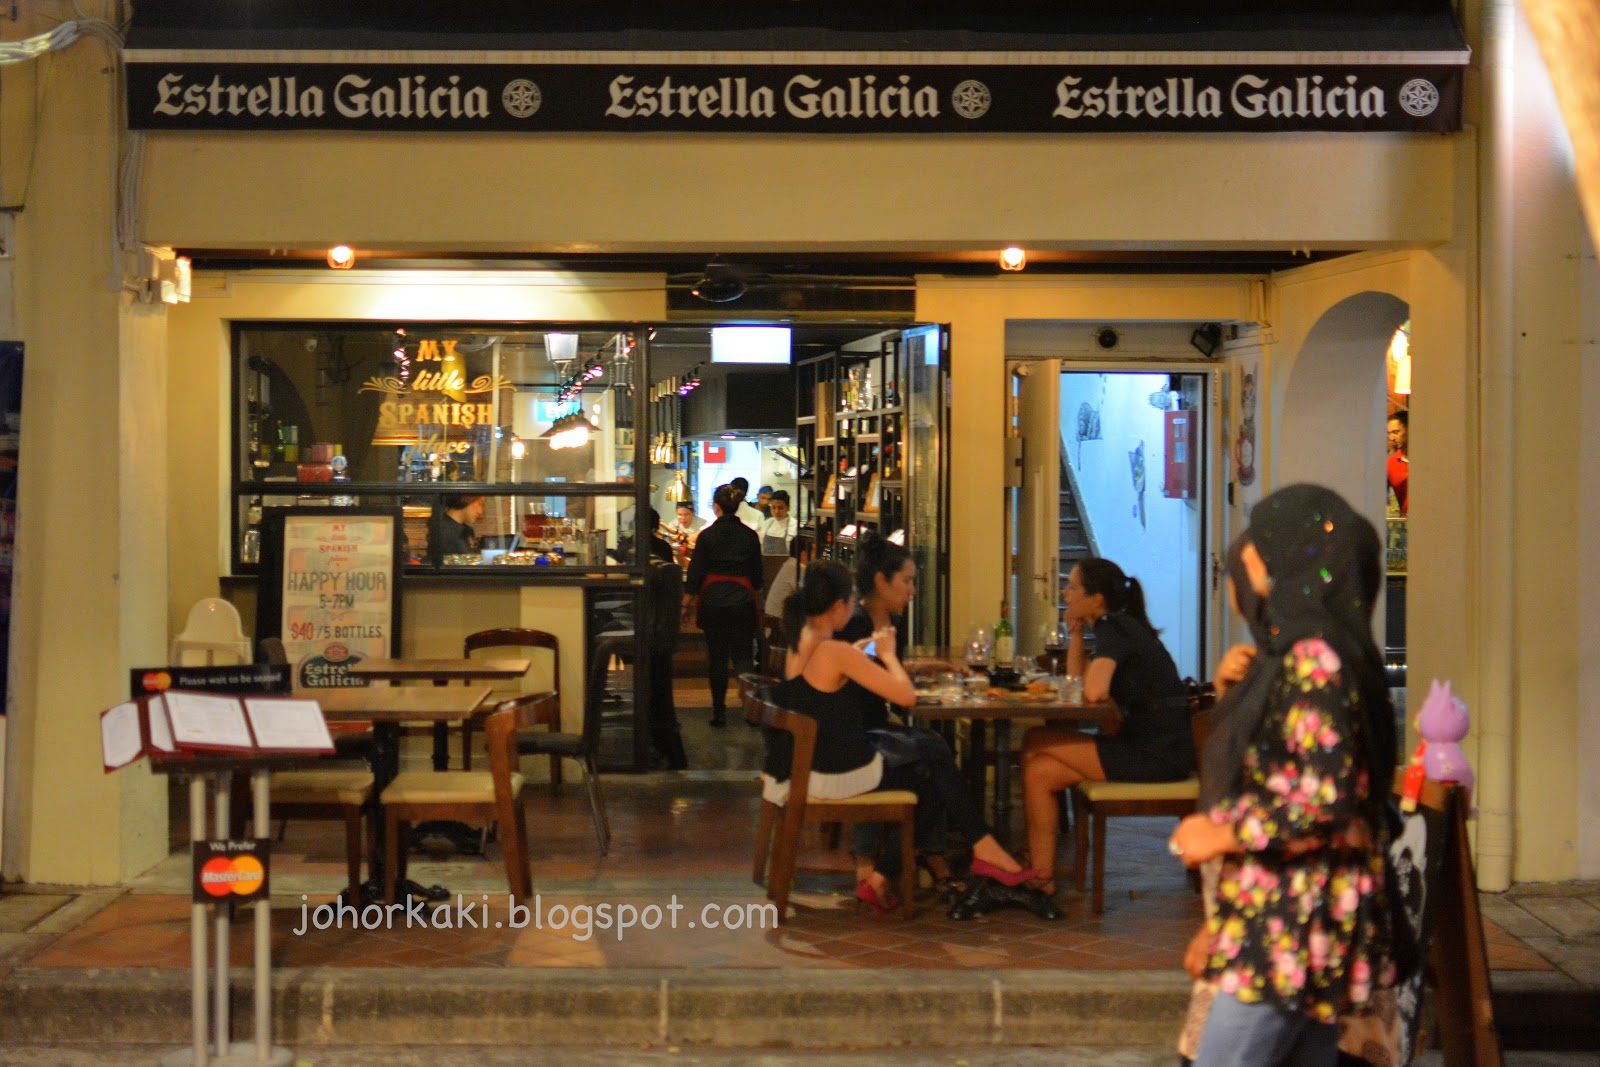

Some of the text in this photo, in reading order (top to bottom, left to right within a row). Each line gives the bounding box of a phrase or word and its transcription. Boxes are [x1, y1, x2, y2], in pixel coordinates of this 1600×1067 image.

[153, 73, 490, 118] Estrella Galicia
[604, 74, 940, 119] Estrella Galicia
[1052, 74, 1387, 119] Estrella Galicia
[415, 339, 458, 362] MY
[411, 369, 466, 391] little
[378, 402, 493, 429] SPANISH
[287, 572, 387, 591] HAPPY HOUR
[319, 594, 355, 609] 5-7PM
[334, 625, 383, 639] BOTTLES
[304, 663, 353, 675] Estre
[209, 841, 256, 851] We Prefer
[203, 870, 262, 883] MasterCard
